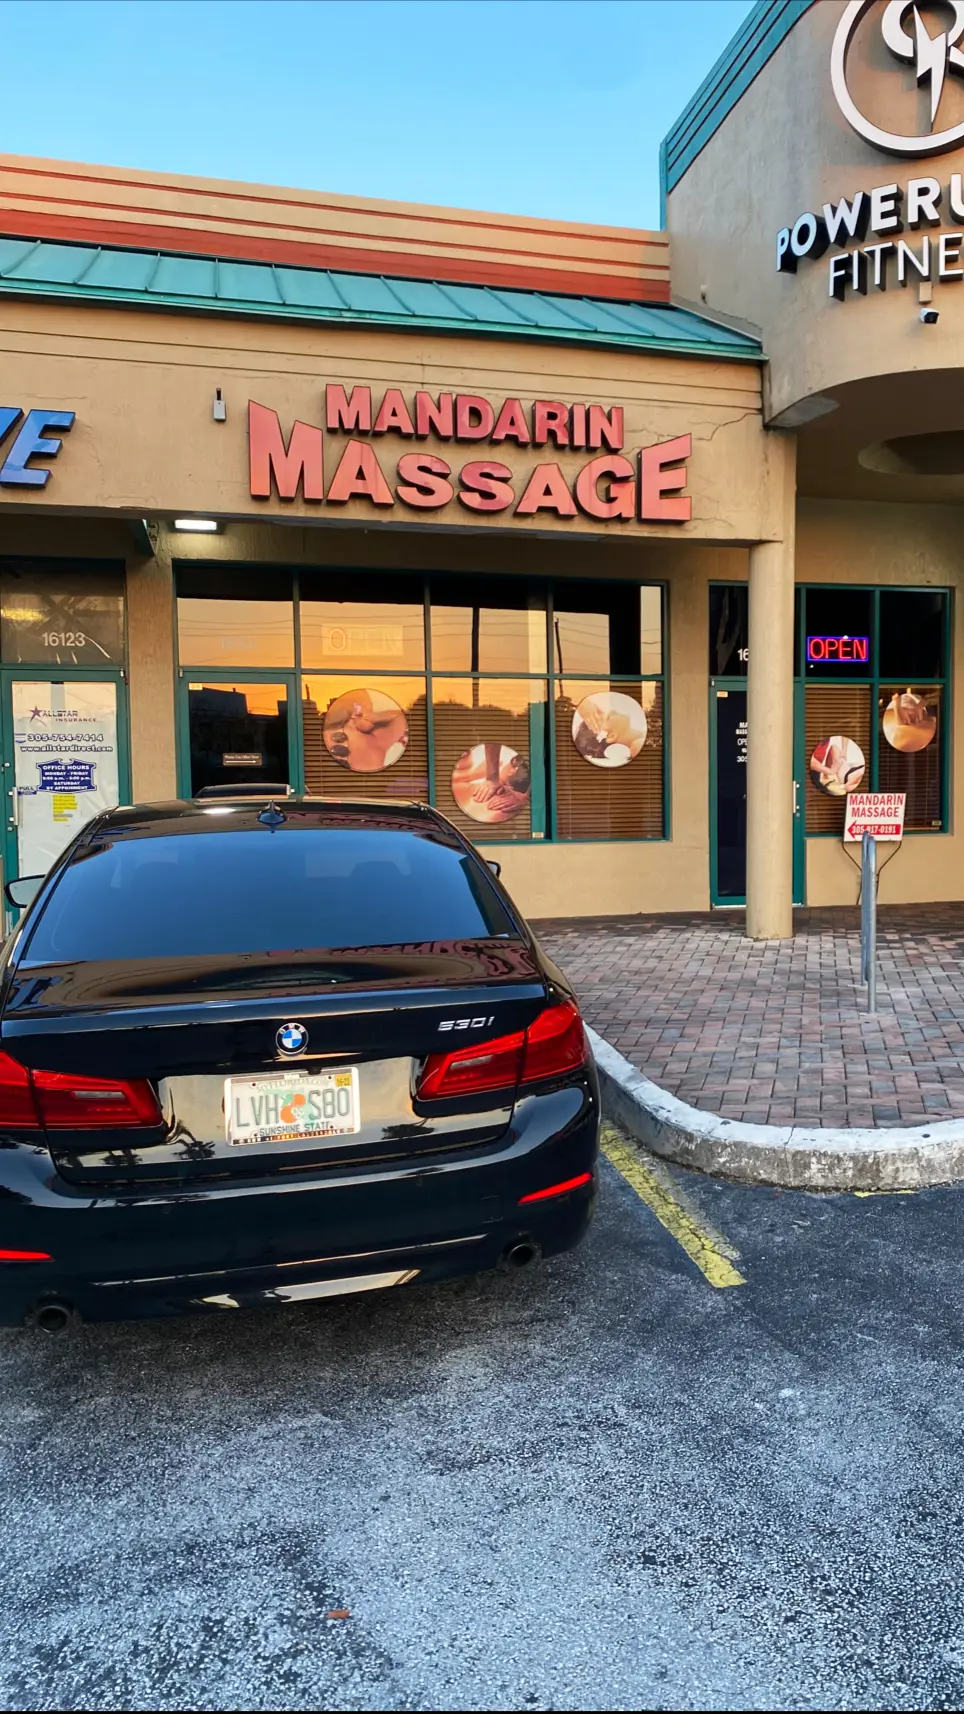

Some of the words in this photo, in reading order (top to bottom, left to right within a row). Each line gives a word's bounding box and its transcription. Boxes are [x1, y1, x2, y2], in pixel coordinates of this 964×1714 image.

[325, 383, 625, 452] MANDARIN
[248, 399, 692, 522] MASSAGE
[42, 632, 86, 647] 16123
[810, 638, 867, 660] OPEN
[20, 744, 113, 752] www.allstardirect.com
[849, 795, 904, 806] MANDARIN
[851, 807, 900, 818] MASSAGE
[236, 1094, 279, 1128] LVH
[259, 1124, 301, 1137] SUNSHINE
[304, 1121, 331, 1133] STATE
